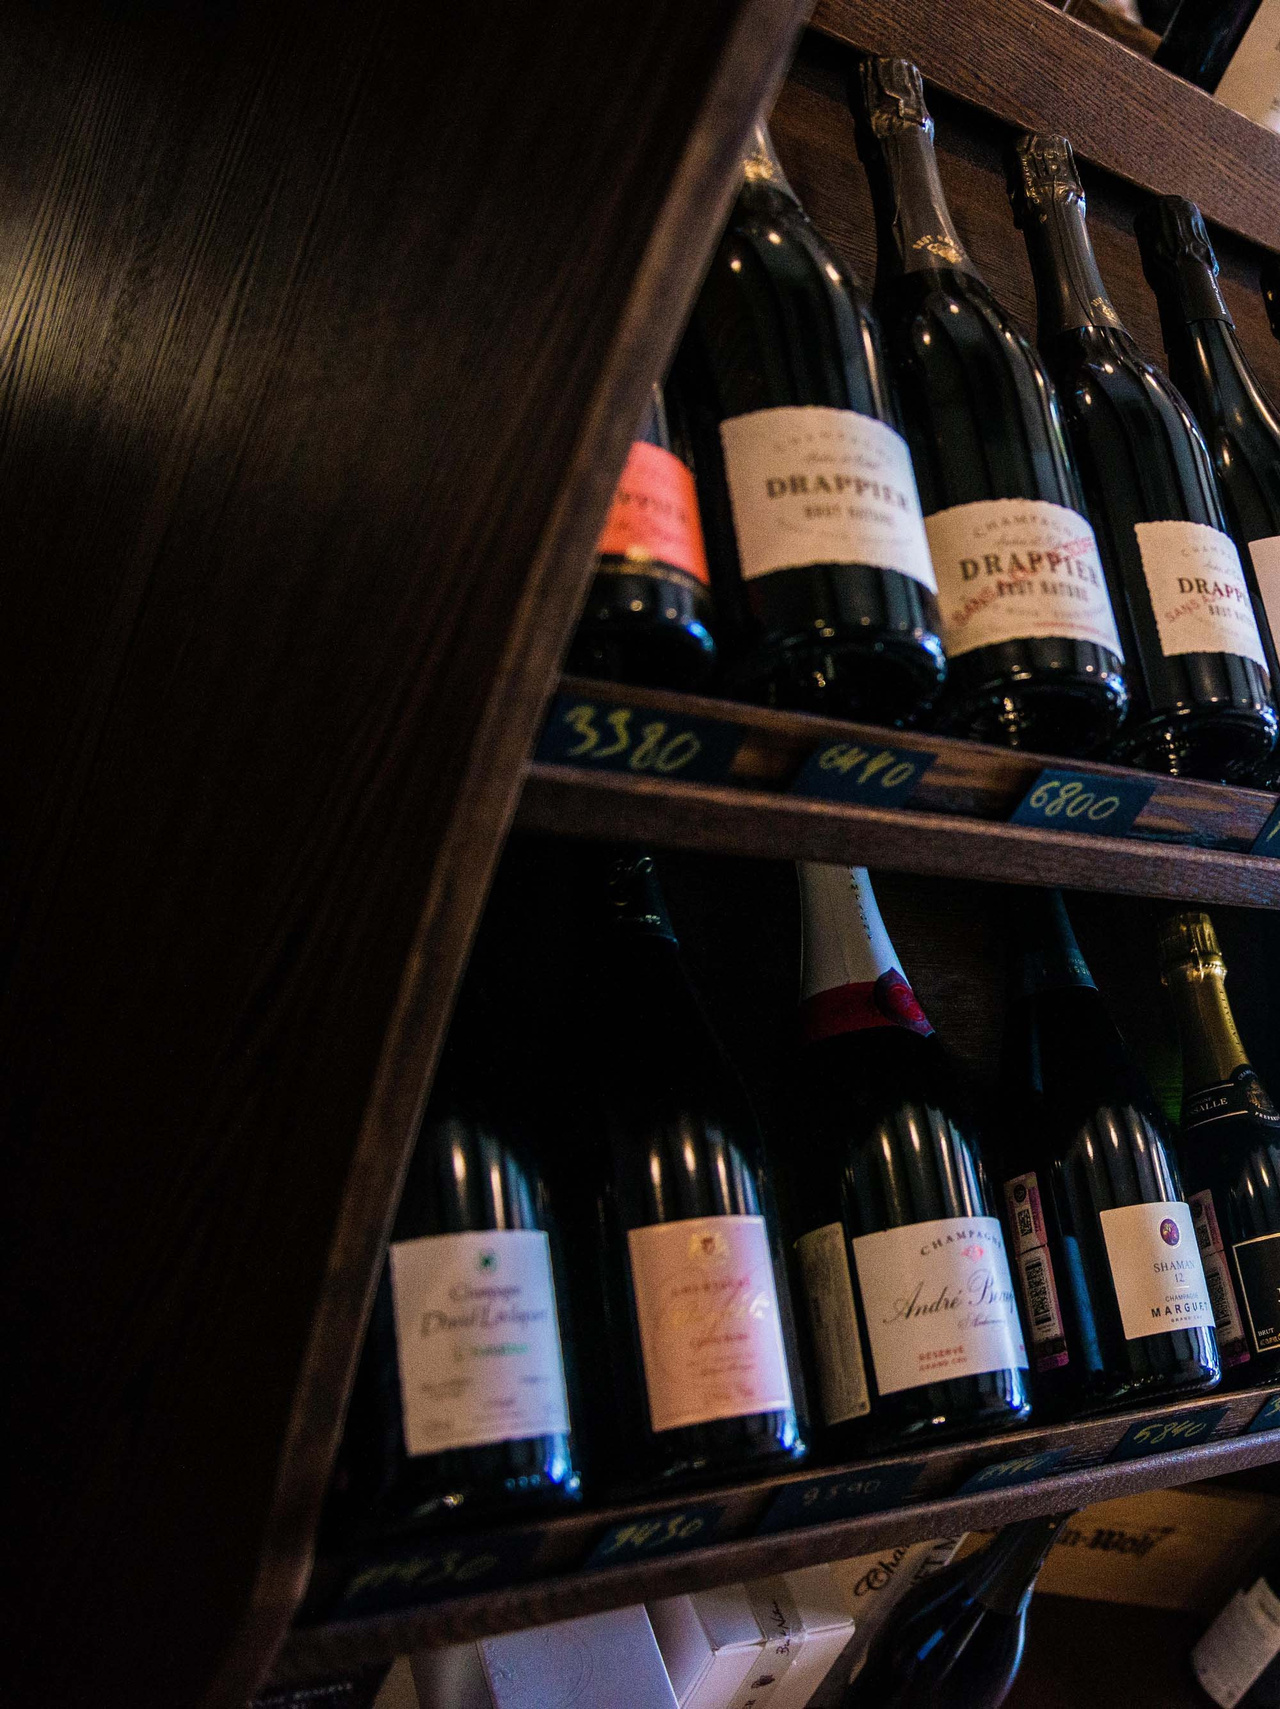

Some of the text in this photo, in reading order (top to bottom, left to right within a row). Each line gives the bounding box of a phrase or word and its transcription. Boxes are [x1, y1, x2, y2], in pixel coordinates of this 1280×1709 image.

[959, 550, 1101, 591] DRAPPIER
[1029, 780, 1120, 821] 6800
[1153, 1259, 1196, 1274] SHAMAN
[1174, 1272, 1185, 1283] 12
[882, 1280, 962, 1324] André
[1151, 1301, 1209, 1318] MARGUET
[1258, 1327, 1275, 1337] BRUT
[1132, 1420, 1207, 1447] 5840
